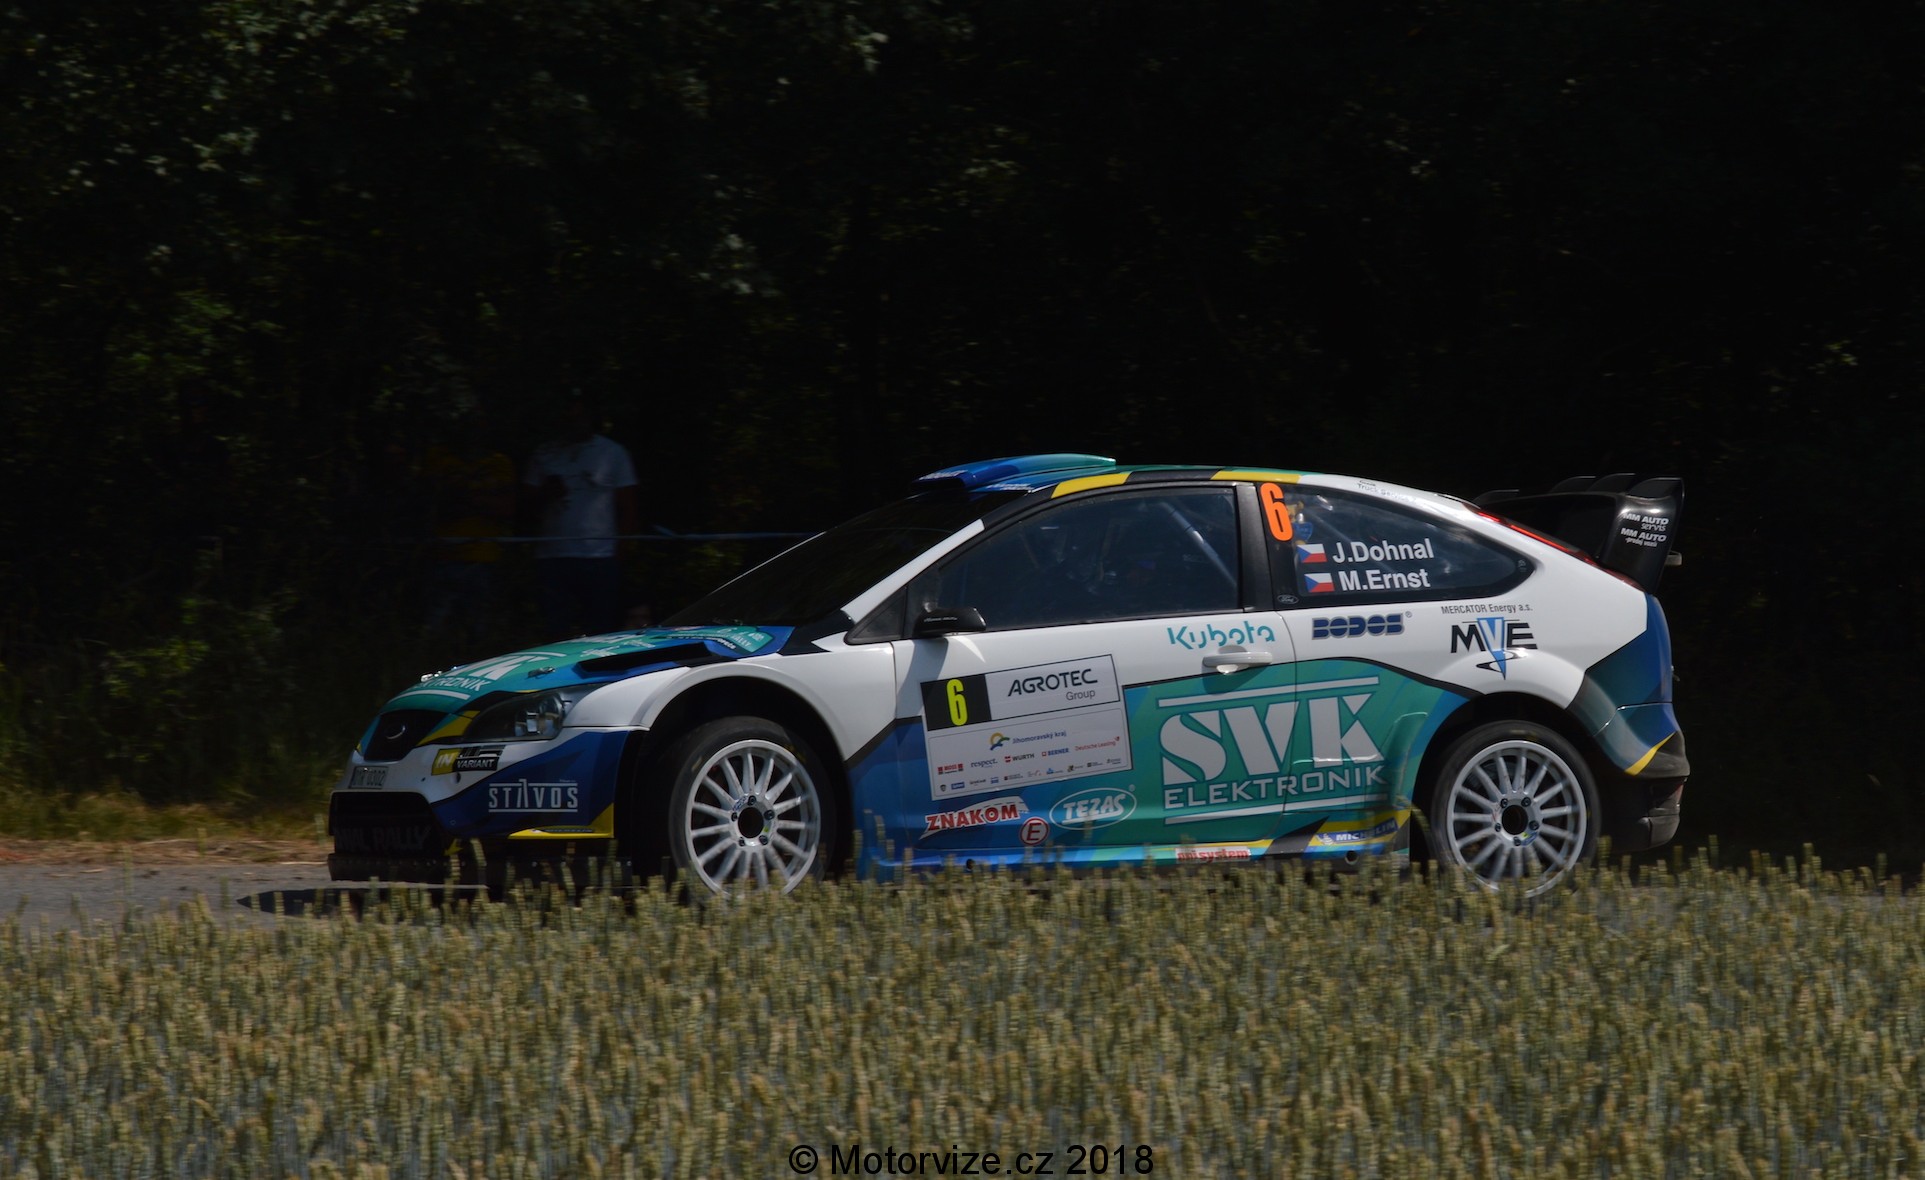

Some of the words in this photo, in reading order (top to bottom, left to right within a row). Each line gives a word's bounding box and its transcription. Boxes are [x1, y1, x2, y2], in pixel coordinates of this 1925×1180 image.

[1259, 482, 1294, 541] 6
[1641, 516, 1669, 525] AUTO
[1620, 527, 1638, 537] MM
[1638, 532, 1667, 542] AUTO
[1332, 538, 1434, 563] J.Dohnal
[1338, 568, 1431, 591] M.Ernst
[1441, 604, 1487, 614] MERCATOR
[1488, 603, 1516, 615] Energy
[1518, 602, 1533, 612] a.s.
[1167, 620, 1275, 650] Kubota
[1312, 612, 1405, 640] BODOS
[1450, 617, 1538, 654] MVE
[1007, 668, 1098, 697] AGROTEC
[1066, 689, 1096, 702] Group
[945, 678, 968, 727] 6
[1159, 693, 1386, 786] SVK
[436, 752, 454, 769] IN
[455, 758, 496, 770] VARIANT
[1164, 765, 1388, 810] ELEKTRONIK
[926, 803, 1019, 831] ZNAKOM
